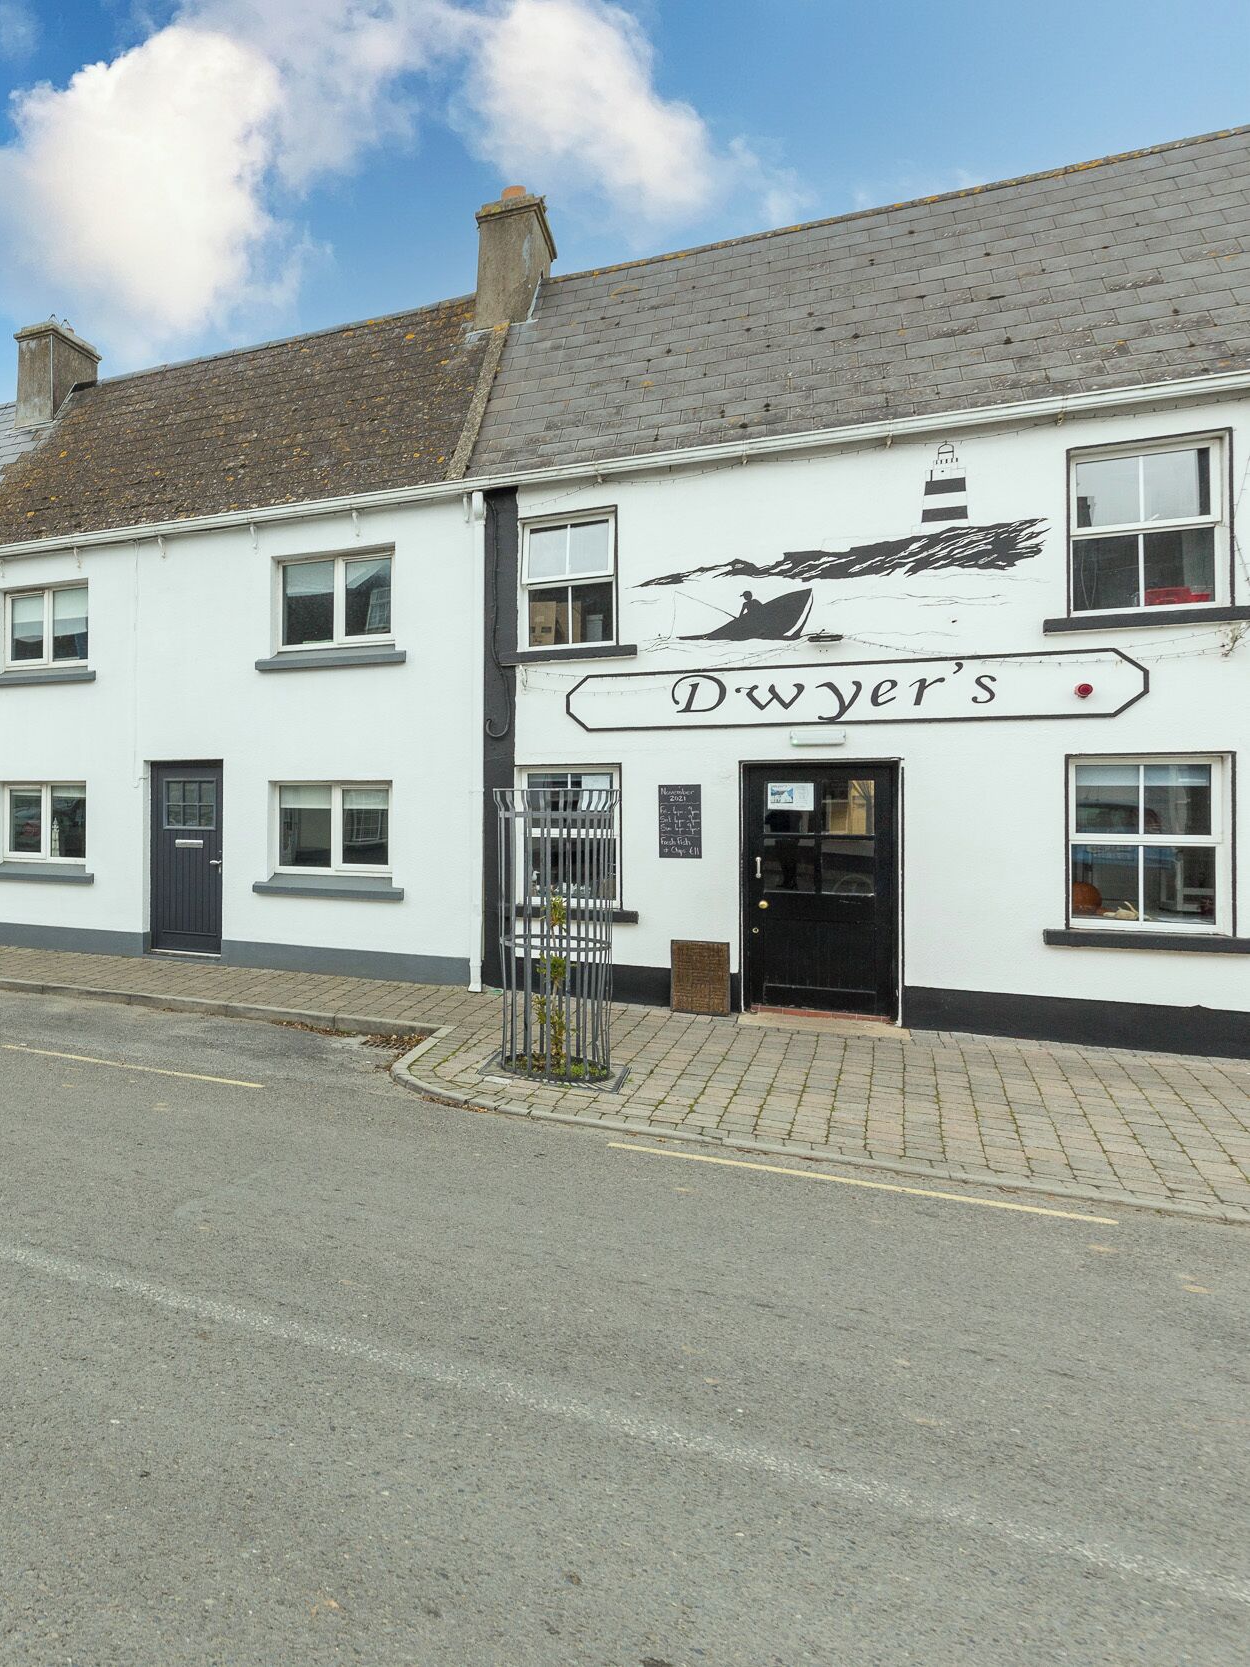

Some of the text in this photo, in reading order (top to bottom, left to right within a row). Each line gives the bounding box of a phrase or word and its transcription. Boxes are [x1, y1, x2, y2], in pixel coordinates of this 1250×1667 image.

[671, 661, 997, 722] Dwyer's
[660, 787, 695, 795] November
[677, 836, 691, 846] Fish
